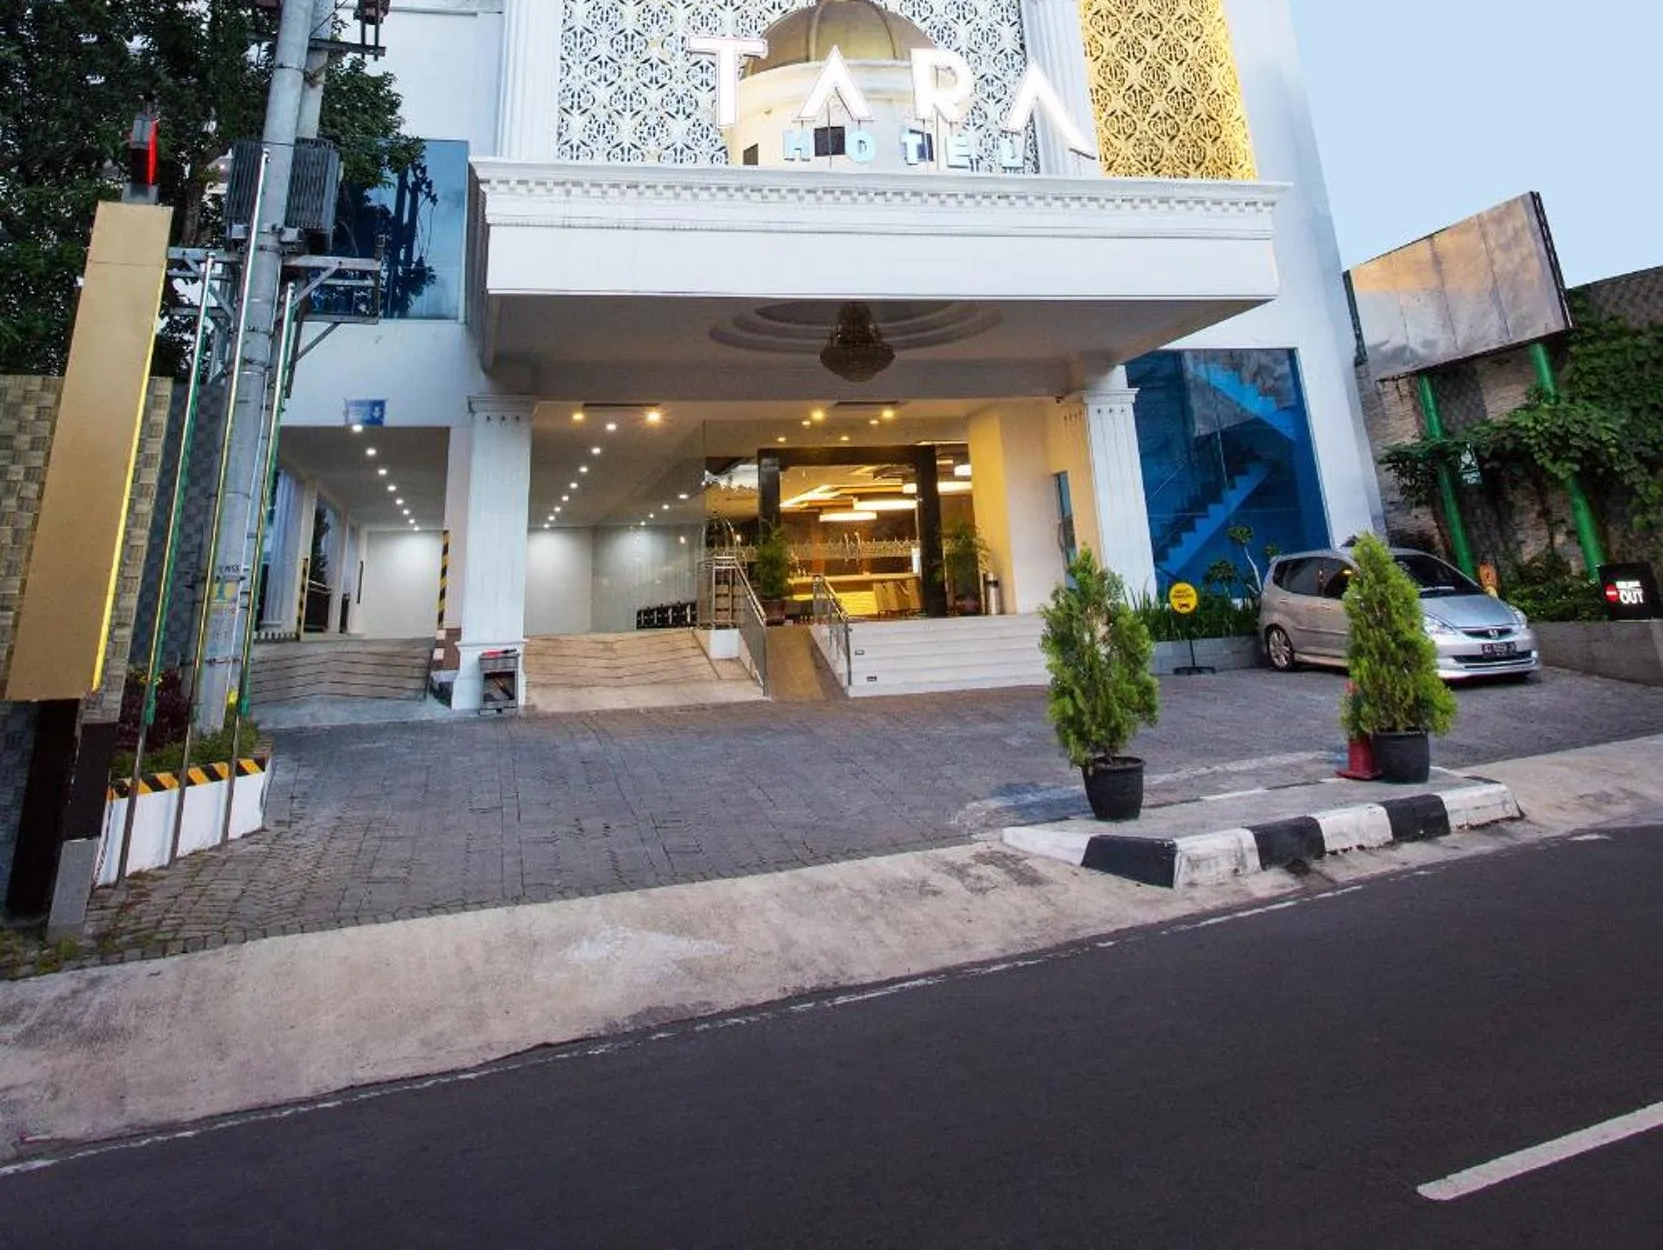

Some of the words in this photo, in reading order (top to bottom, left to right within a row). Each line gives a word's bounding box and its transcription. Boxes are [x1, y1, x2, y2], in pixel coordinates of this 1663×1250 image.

[688, 36, 1097, 160] TARA
[784, 128, 1025, 170] HOTEL
[1618, 588, 1644, 604] OUT
